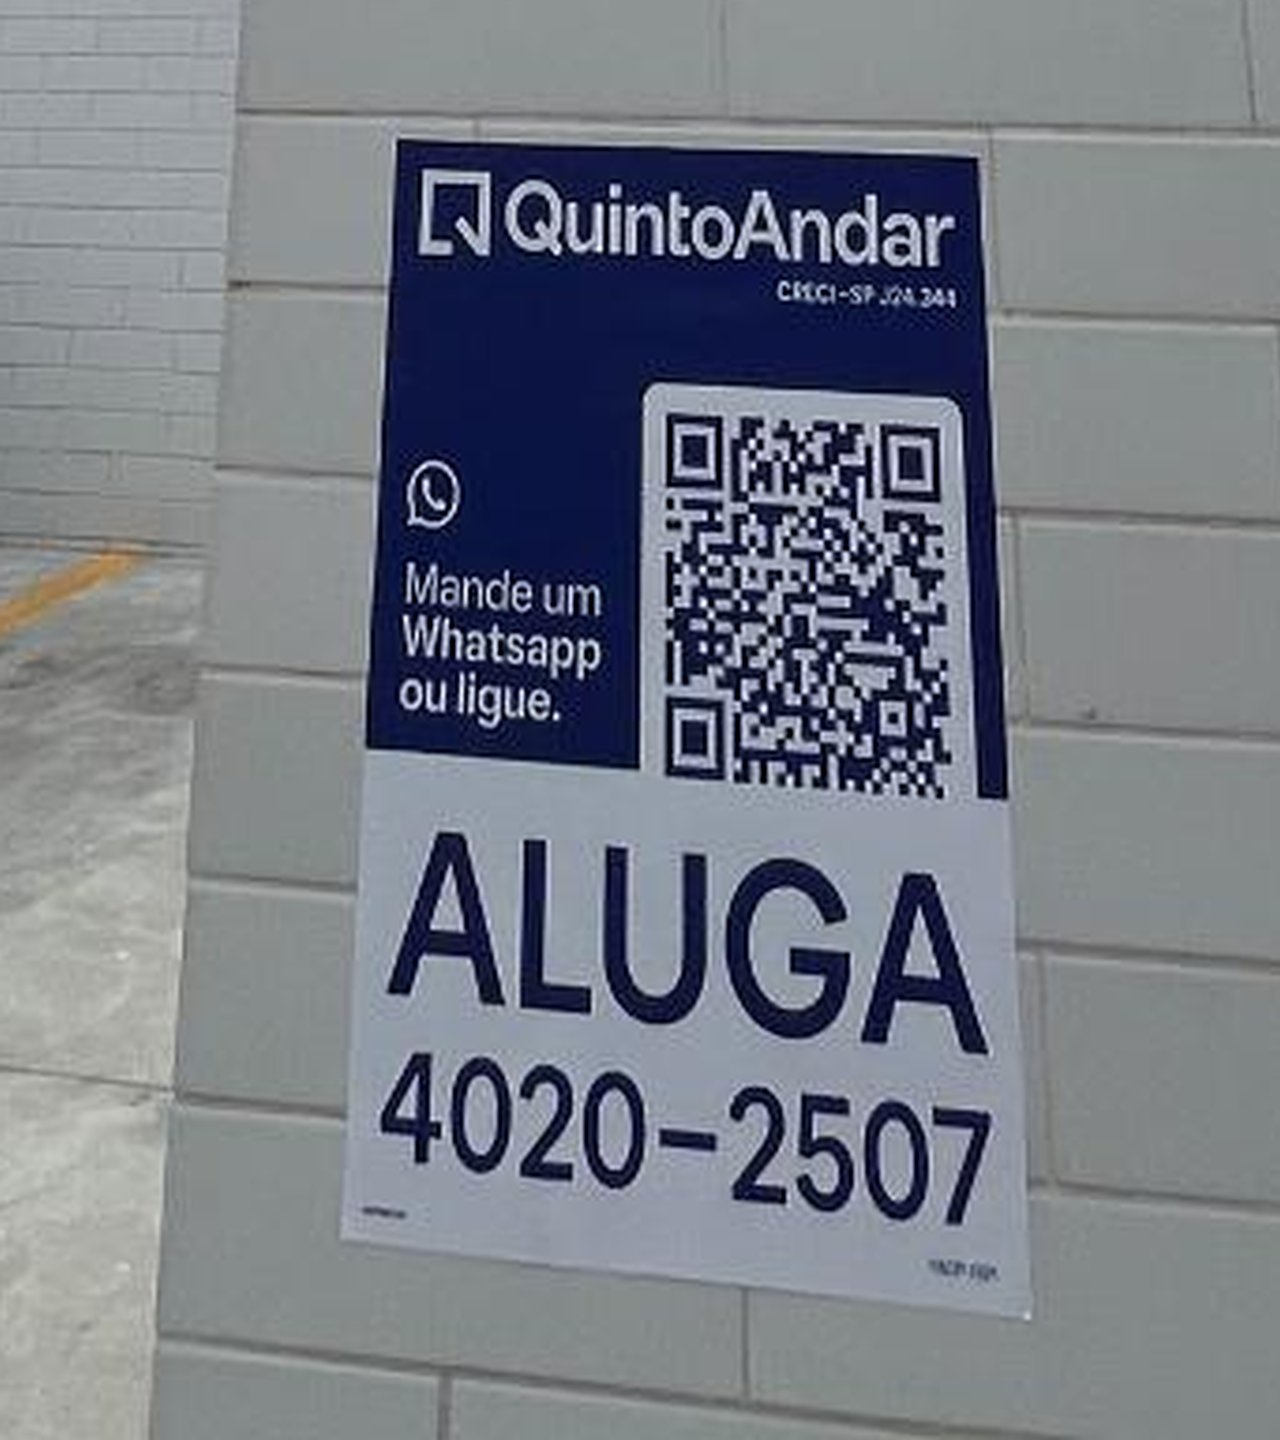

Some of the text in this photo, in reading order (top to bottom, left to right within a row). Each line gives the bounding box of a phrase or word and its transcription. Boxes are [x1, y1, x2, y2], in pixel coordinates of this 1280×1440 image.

[504, 179, 956, 268] QuintoAndar
[405, 561, 602, 617] Mande um
[402, 613, 602, 681] Whatsapp
[399, 671, 562, 728] ou ligue.
[386, 830, 990, 1056] ALUGA
[379, 1051, 992, 1226] 4020-2507
